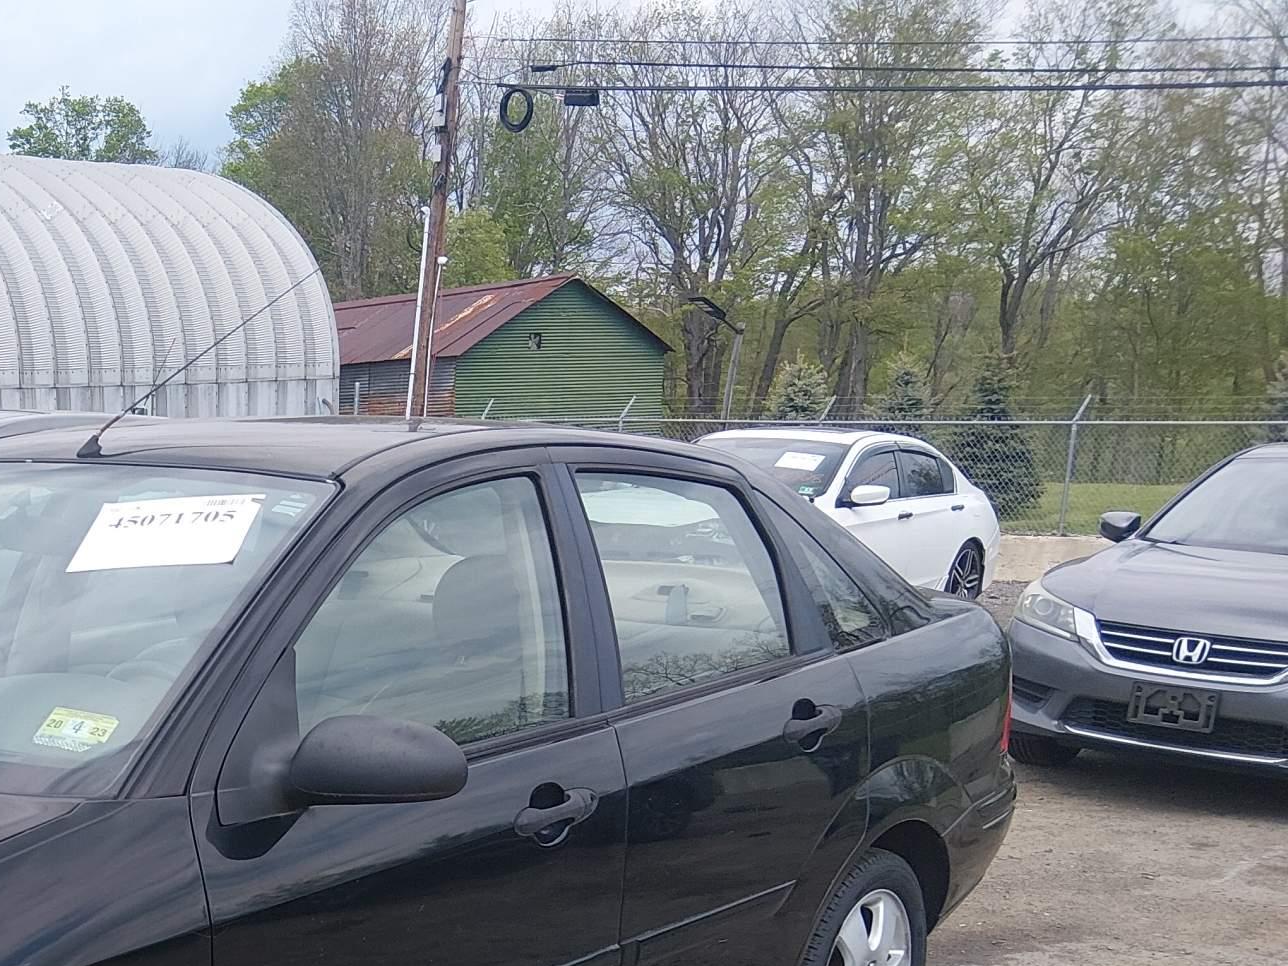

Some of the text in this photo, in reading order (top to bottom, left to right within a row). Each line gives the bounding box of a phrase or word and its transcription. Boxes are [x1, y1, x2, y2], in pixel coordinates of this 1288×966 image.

[109, 510, 237, 529] 45071705
[46, 718, 108, 737] 20 4 23
